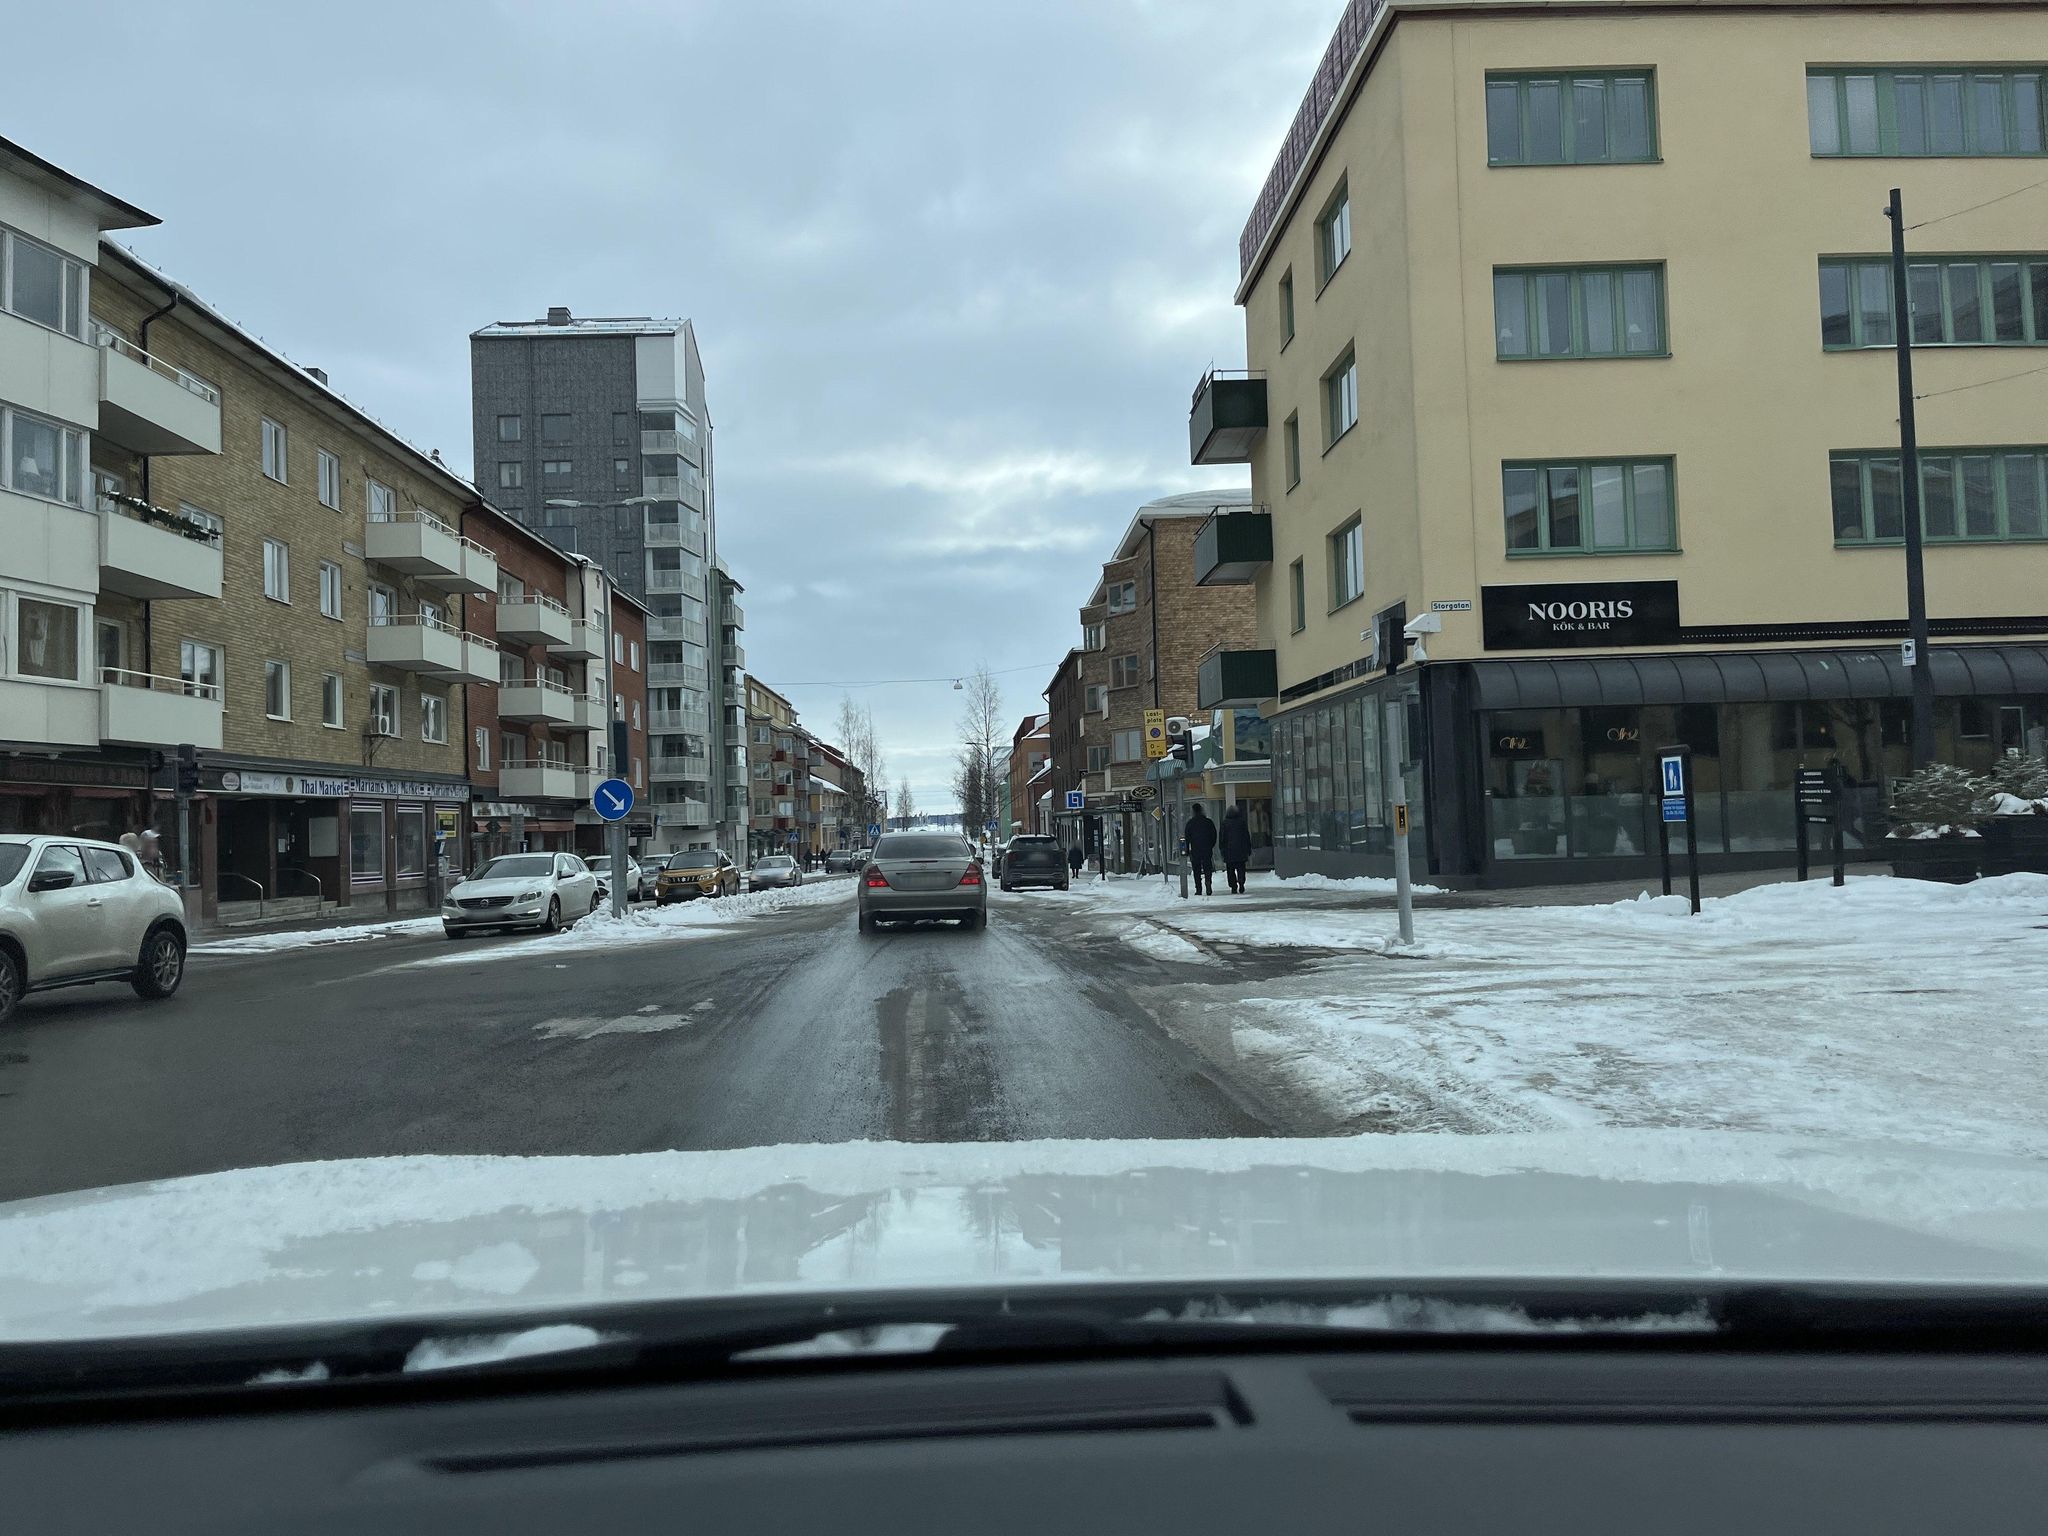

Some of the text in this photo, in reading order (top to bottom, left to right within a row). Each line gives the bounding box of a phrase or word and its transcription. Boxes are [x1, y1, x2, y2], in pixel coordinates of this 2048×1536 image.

[1433, 603, 1470, 611] Storgatan
[1528, 600, 1633, 620] NOORIS
[1553, 621, 1610, 631] KÖK & BAR
[319, 780, 344, 796] Market
